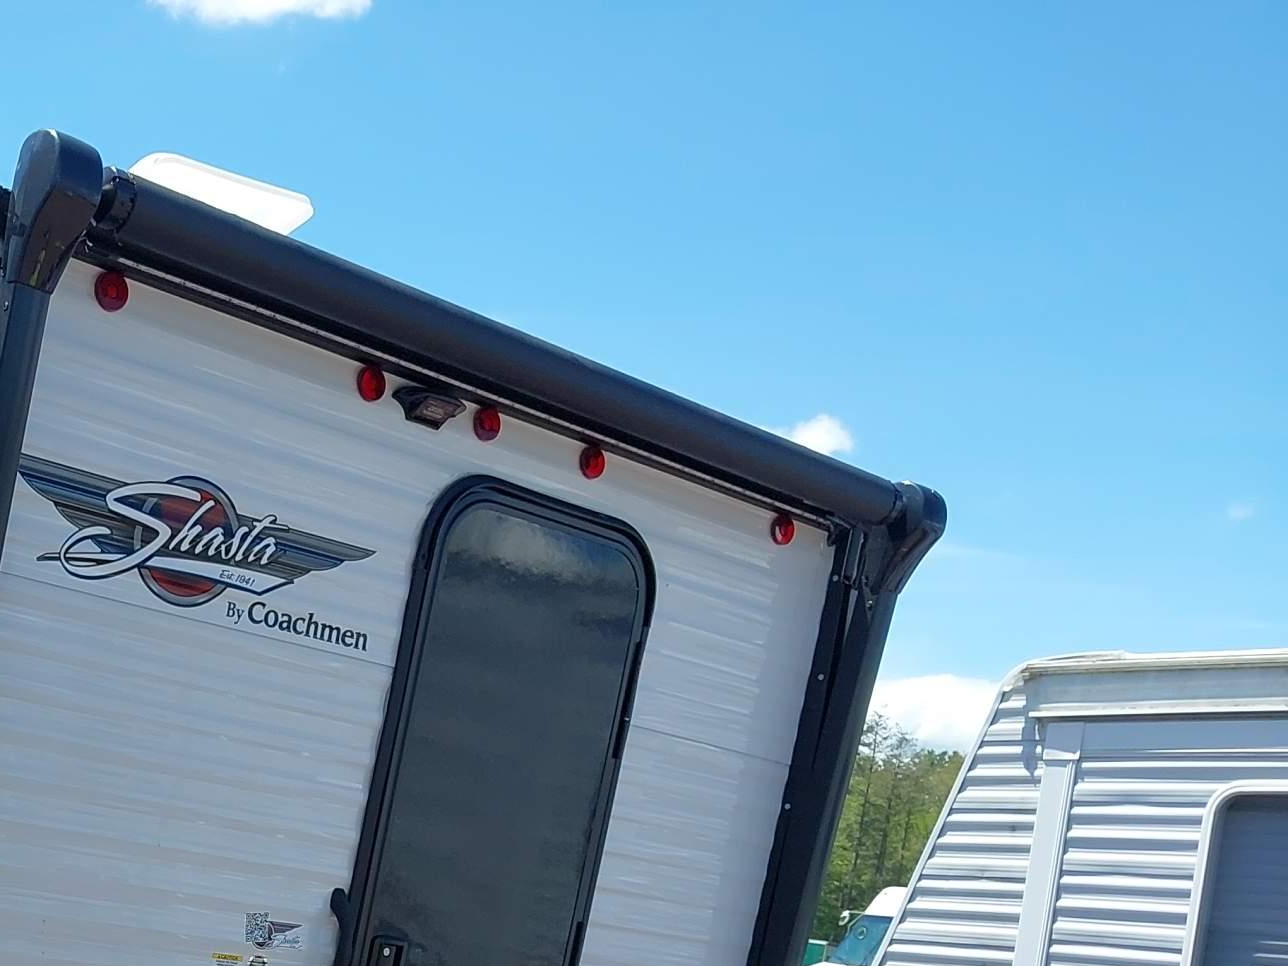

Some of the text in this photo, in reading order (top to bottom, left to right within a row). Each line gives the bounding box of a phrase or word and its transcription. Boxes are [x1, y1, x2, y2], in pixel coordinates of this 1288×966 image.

[60, 481, 290, 580] Shasta
[226, 601, 368, 651] By Coachmen
